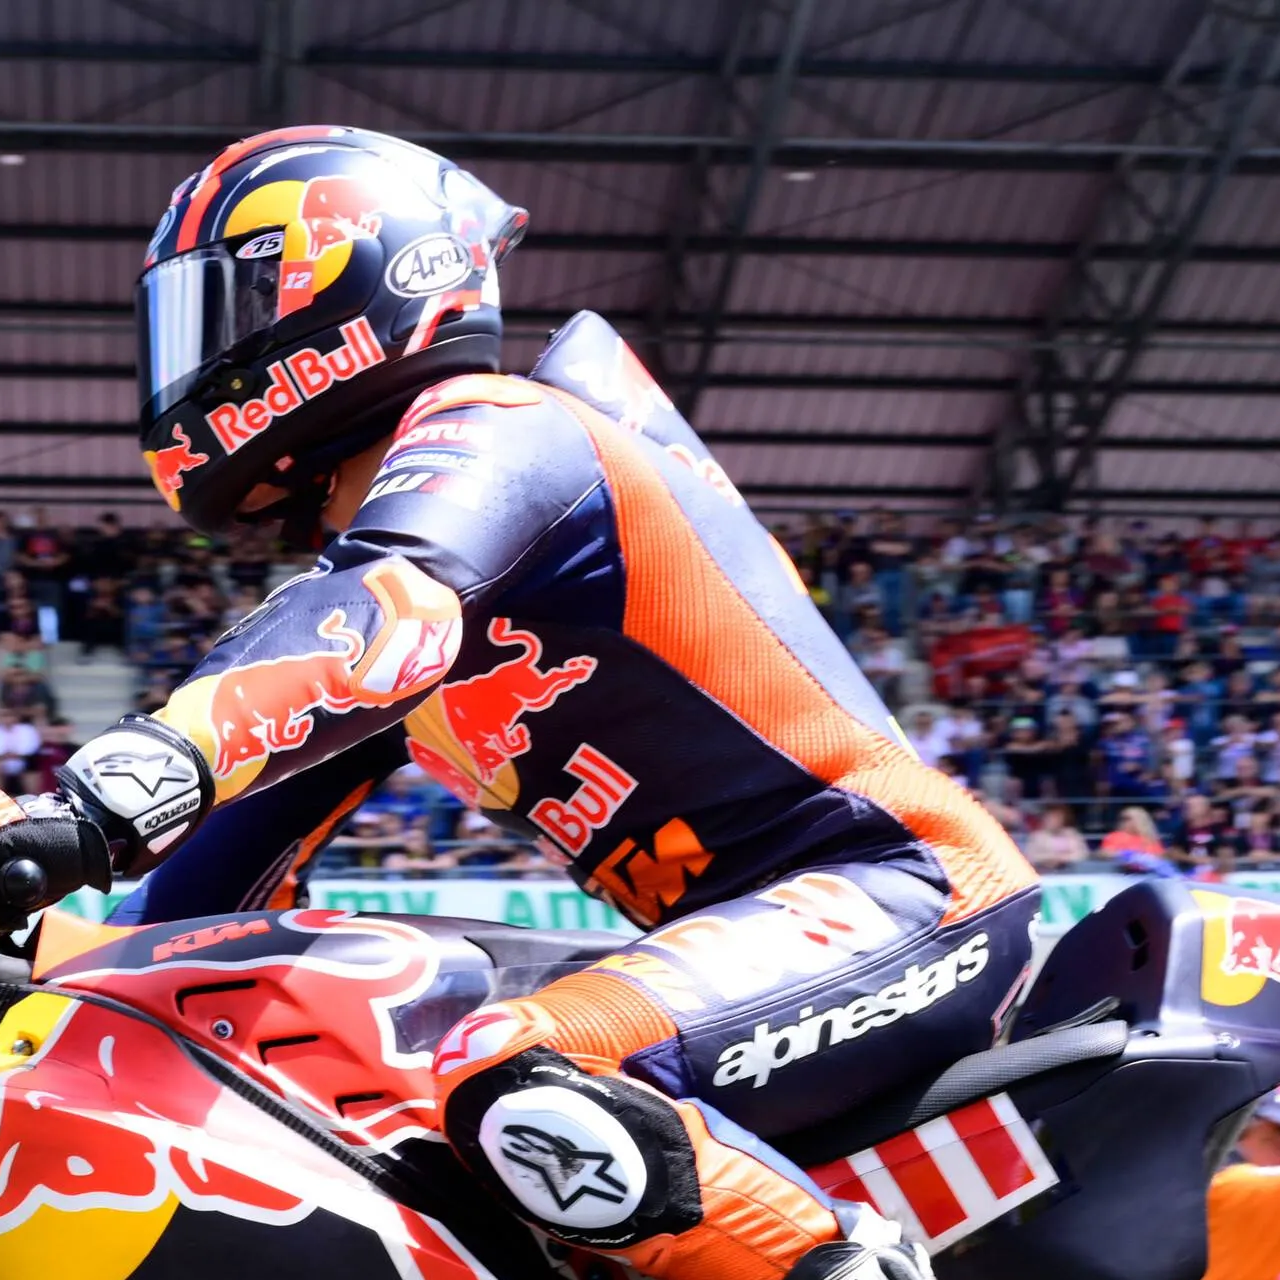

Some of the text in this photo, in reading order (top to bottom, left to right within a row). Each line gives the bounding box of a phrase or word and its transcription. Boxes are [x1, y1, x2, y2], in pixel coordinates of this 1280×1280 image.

[283, 271, 313, 290] 12
[206, 316, 386, 456] Red Bull
[527, 743, 639, 858] Bull
[151, 918, 271, 962] KTM
[712, 931, 990, 1089] alpinestars
